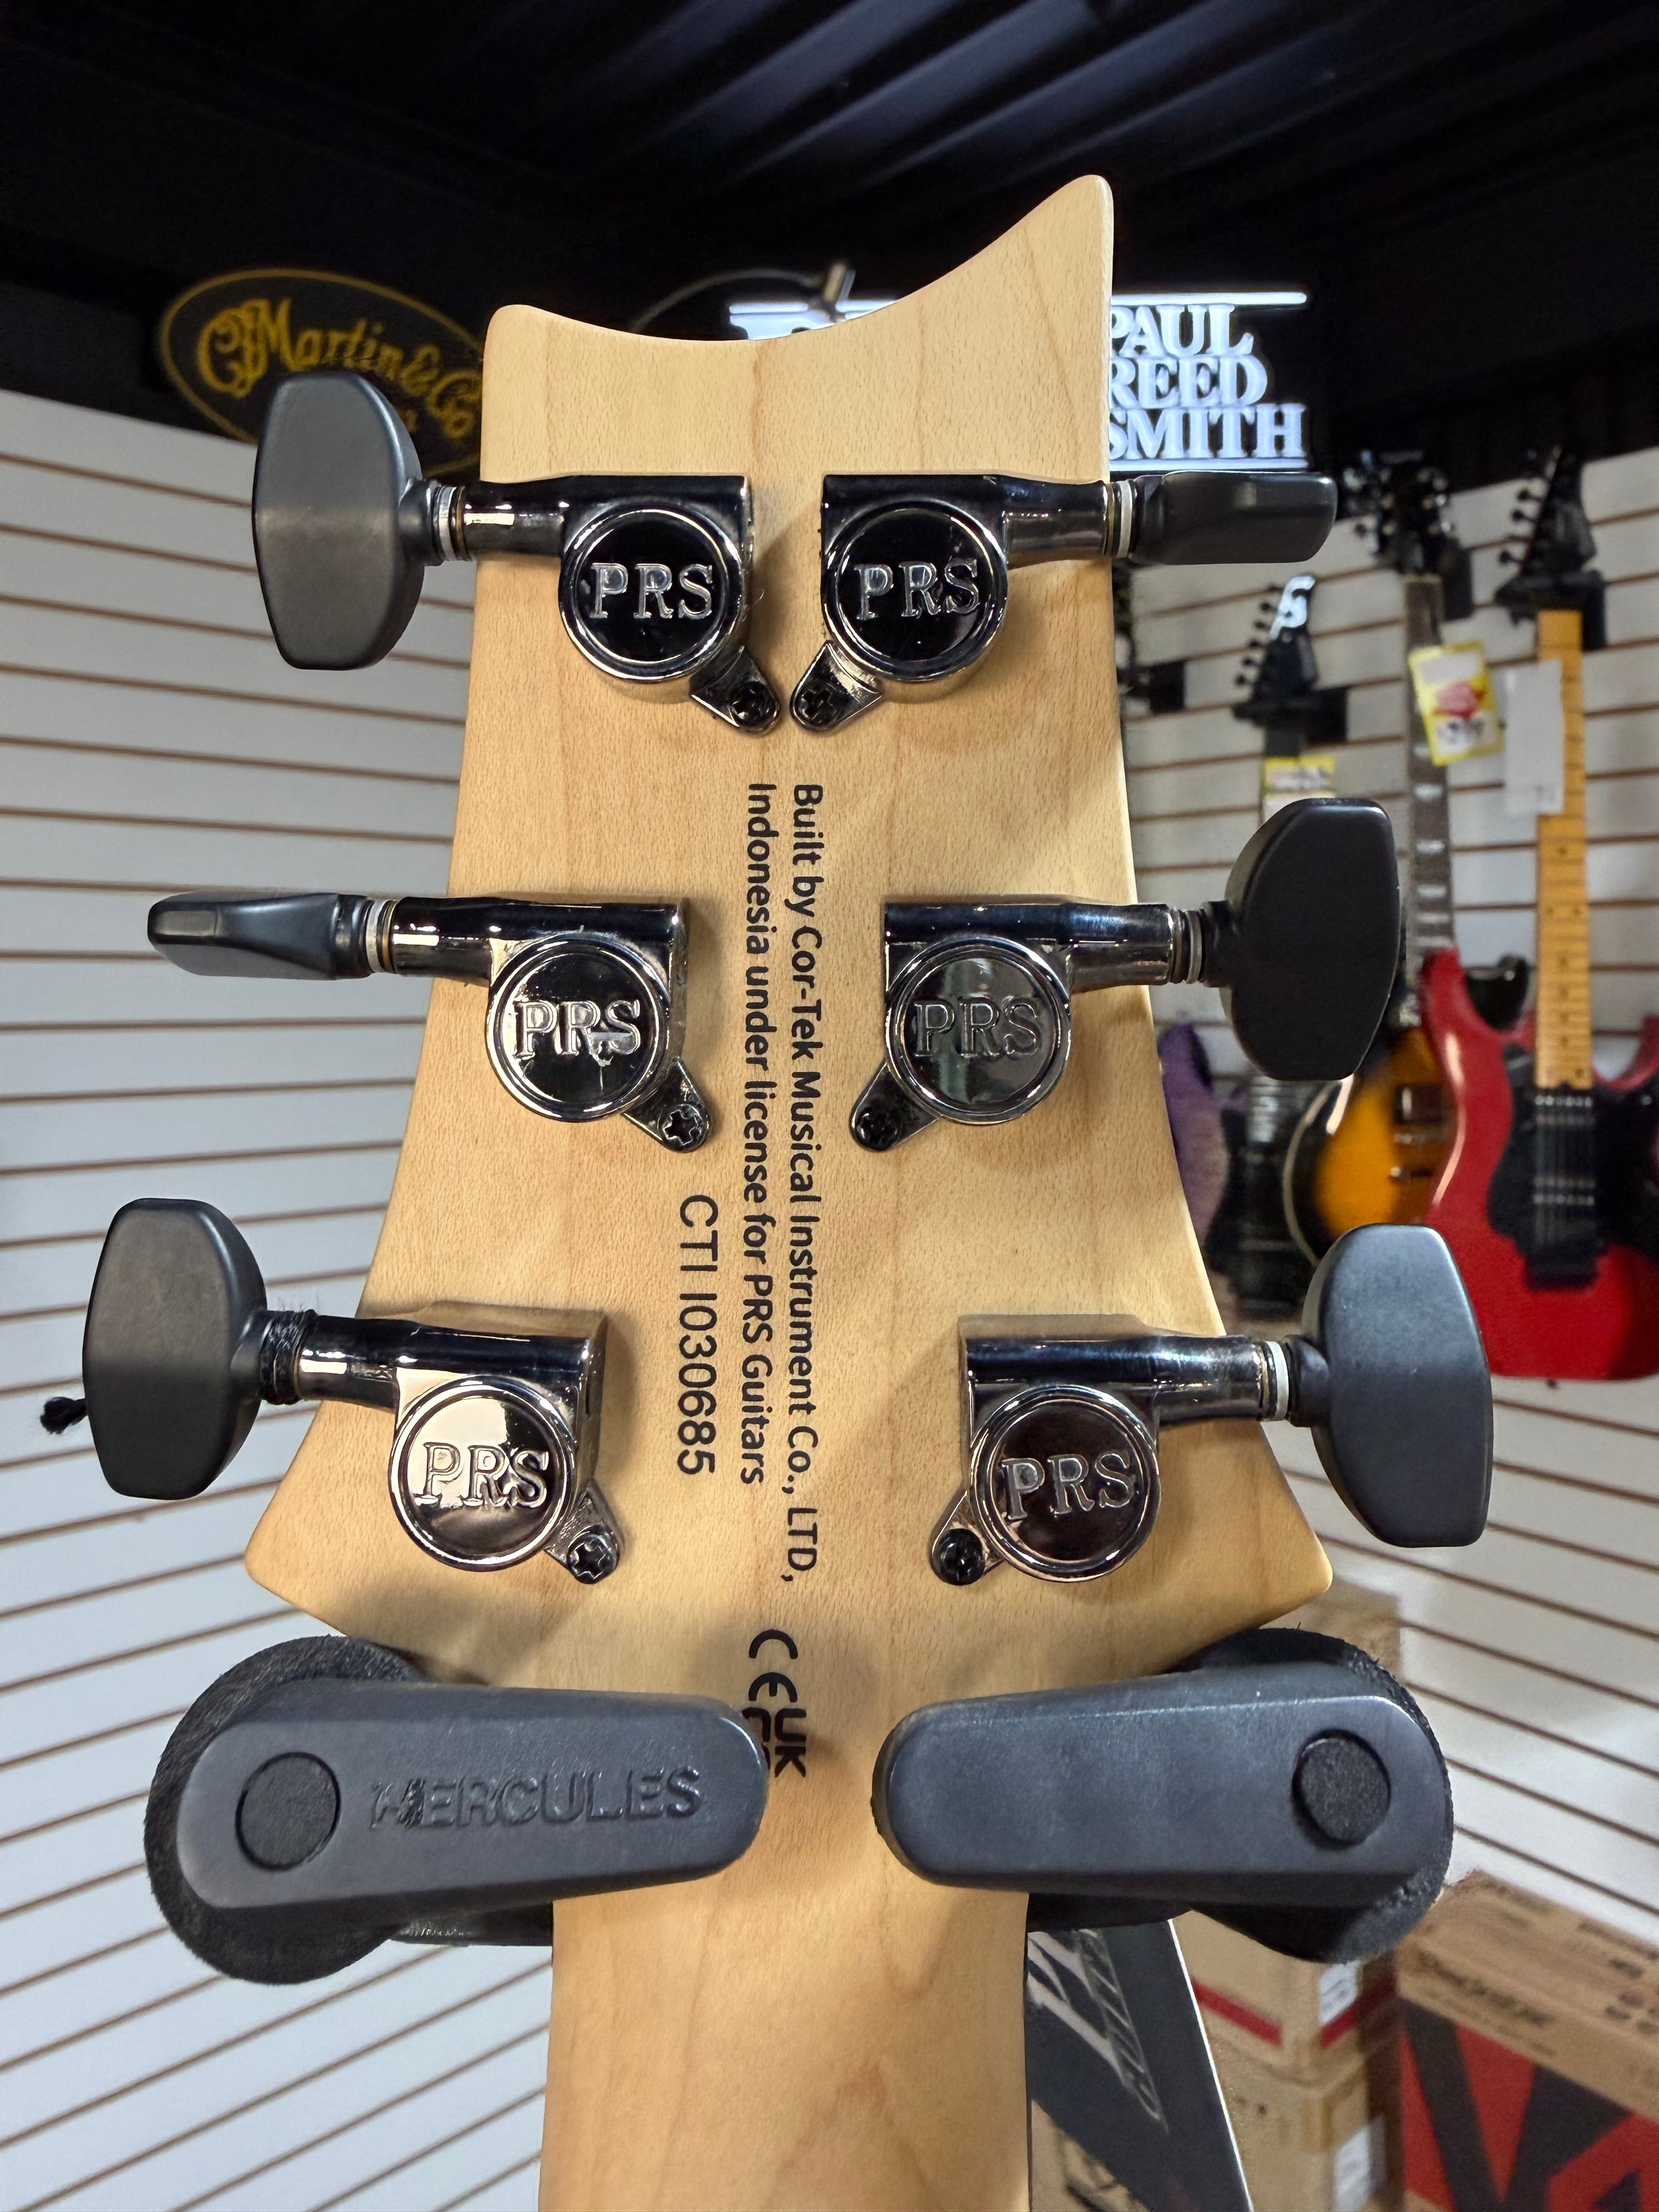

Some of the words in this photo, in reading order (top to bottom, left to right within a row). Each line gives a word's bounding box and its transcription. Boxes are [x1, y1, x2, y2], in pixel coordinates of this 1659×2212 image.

[589, 562, 714, 620] PRS
[855, 557, 980, 620] PRS
[792, 784, 825, 866] Built
[746, 783, 780, 955] Indonesia
[784, 876, 825, 917] by
[745, 966, 777, 1071] under
[791, 925, 823, 1060] Cor-Tek
[913, 996, 1042, 1059] PRS
[512, 998, 641, 1060] PRS
[743, 1081, 777, 1203] license
[789, 1071, 822, 1203] Musical
[680, 1194, 719, 1272] CTI
[743, 1213, 776, 1265] for
[742, 1274, 774, 1344] PRS
[788, 1216, 820, 1415] Instrument
[741, 1354, 773, 1484] Guitars
[413, 1441, 550, 1509] PRS
[782, 1426, 819, 1494] Co.,
[1001, 1449, 1136, 1522] PRS
[370, 1764, 700, 1829] HERCULES
